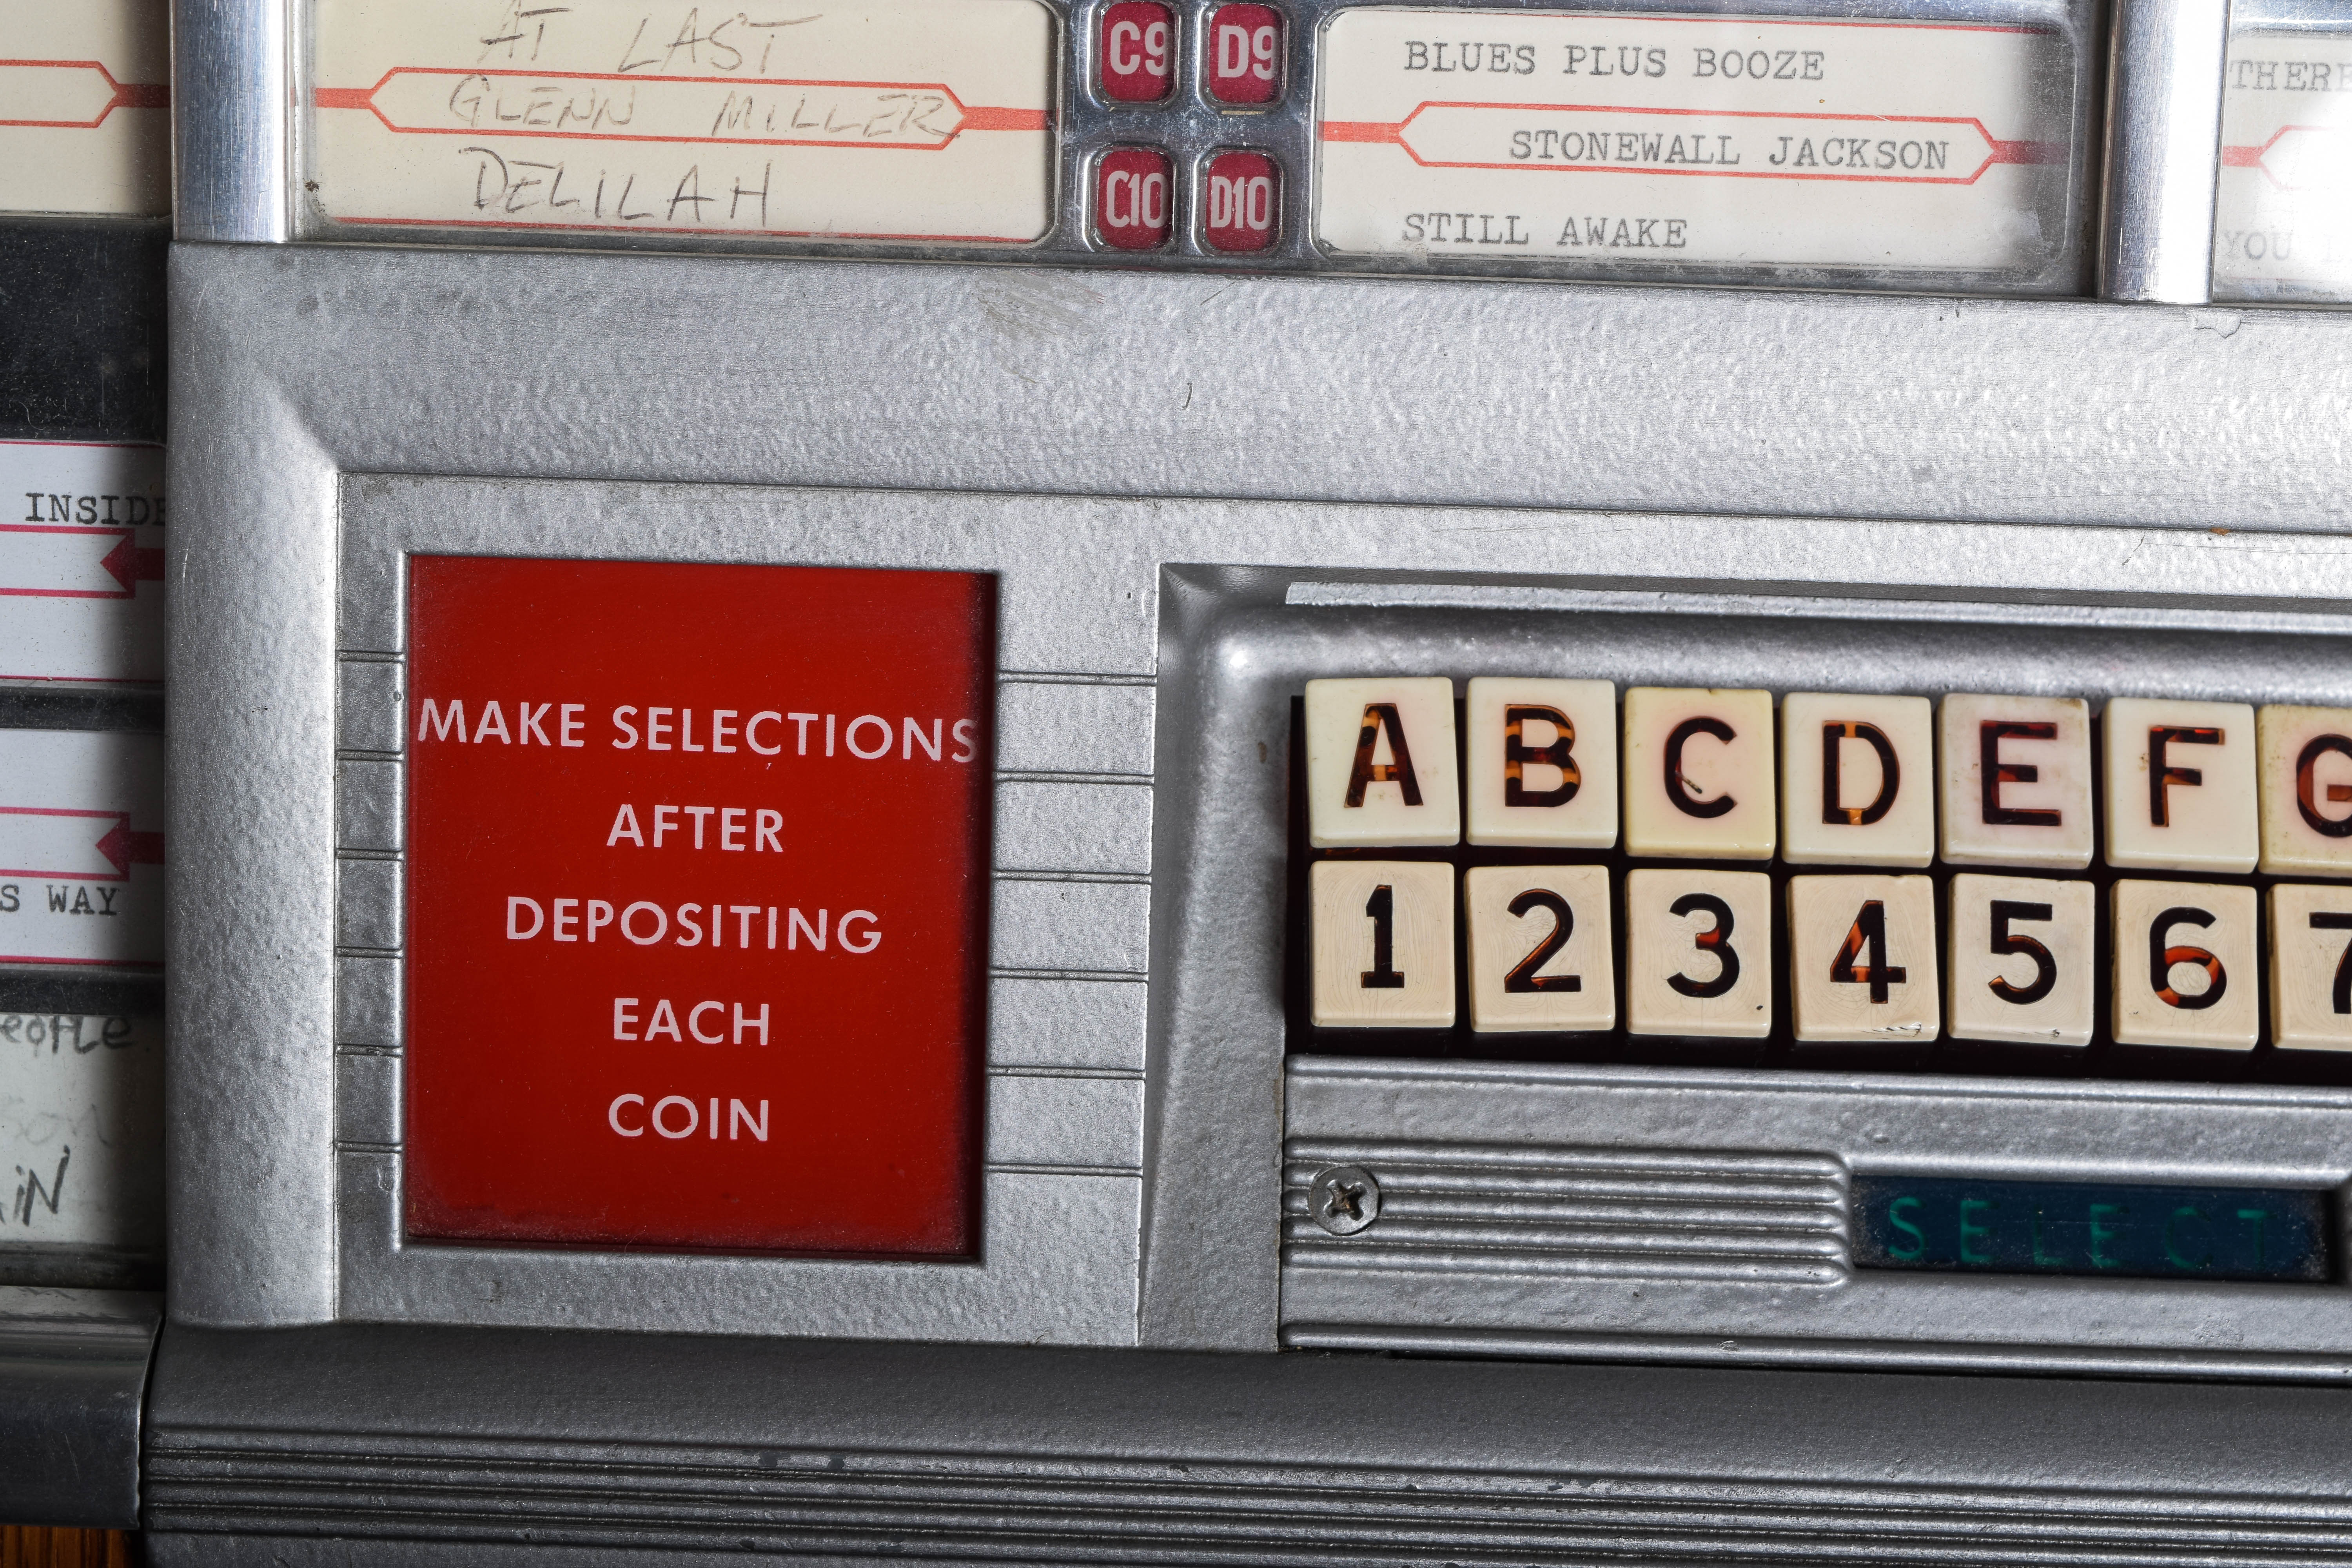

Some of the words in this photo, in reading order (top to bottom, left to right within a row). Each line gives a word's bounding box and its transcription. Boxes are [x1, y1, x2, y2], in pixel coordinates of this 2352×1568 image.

[477, 0, 573, 64] AT
[619, 7, 823, 74] LAST
[1110, 21, 1170, 76] C9
[1218, 25, 1279, 80] D9
[1404, 40, 1536, 75] BLUES
[1562, 45, 1667, 78] PLUS
[1691, 48, 1825, 81] BOOZE
[449, 73, 636, 129] GLENN
[711, 90, 960, 138] MILLER
[458, 147, 773, 227] DELILAH
[1509, 130, 1740, 165] STONEWALL
[1769, 136, 1950, 170] JACKSON
[1107, 170, 1167, 229] C10
[1210, 176, 1273, 230] D10
[1402, 213, 1529, 246] STILL
[1556, 216, 1688, 249] AWAKE
[417, 698, 585, 748] MAKE
[611, 705, 979, 763] SELECTIONS
[1344, 702, 1424, 808] A
[1504, 704, 1582, 808] B
[1663, 715, 1738, 818] C
[1822, 720, 1900, 825] D
[1980, 720, 2062, 827] E
[2148, 724, 2225, 828] F
[2296, 733, 2352, 838] G
[606, 804, 784, 852] AFTER
[45, 884, 120, 916] WAY
[506, 896, 882, 954] DEPOSITING
[1361, 884, 1405, 989] 1
[1504, 887, 1582, 993] 2
[1666, 892, 1740, 998] 3
[1830, 899, 1907, 1004] 4
[1987, 899, 2057, 1005] 5
[2149, 906, 2228, 1010] 6
[2308, 911, 2352, 1015] 7
[613, 997, 770, 1046] EACH
[608, 1093, 769, 1142] COIN
[1887, 1196, 2275, 1270] SELECT
